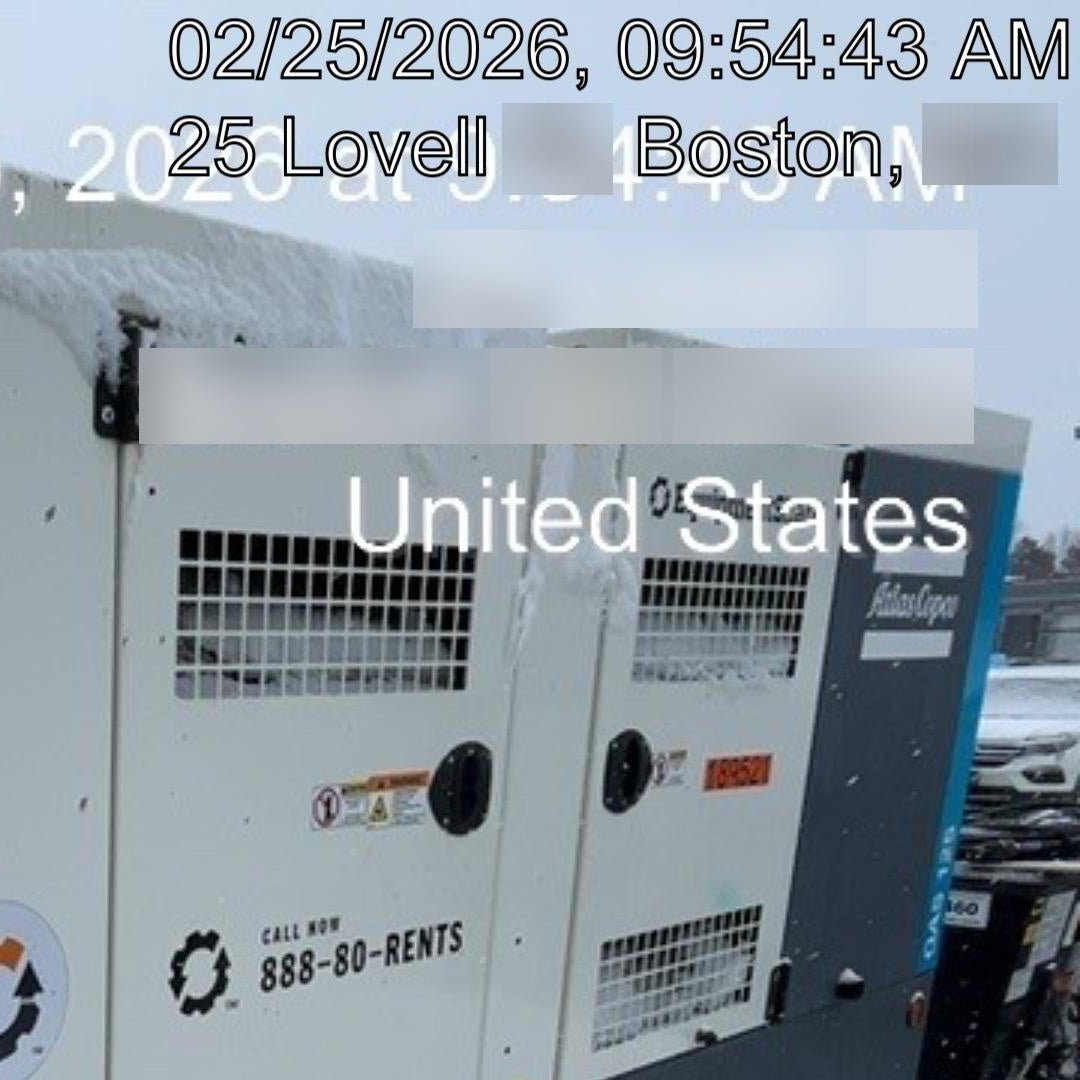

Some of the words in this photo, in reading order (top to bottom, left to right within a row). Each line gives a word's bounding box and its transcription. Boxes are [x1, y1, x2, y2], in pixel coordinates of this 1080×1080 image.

[260, 920, 464, 993] 888-80-RENTS
[261, 922, 301, 946] CALL
[308, 916, 341, 937] NOW
